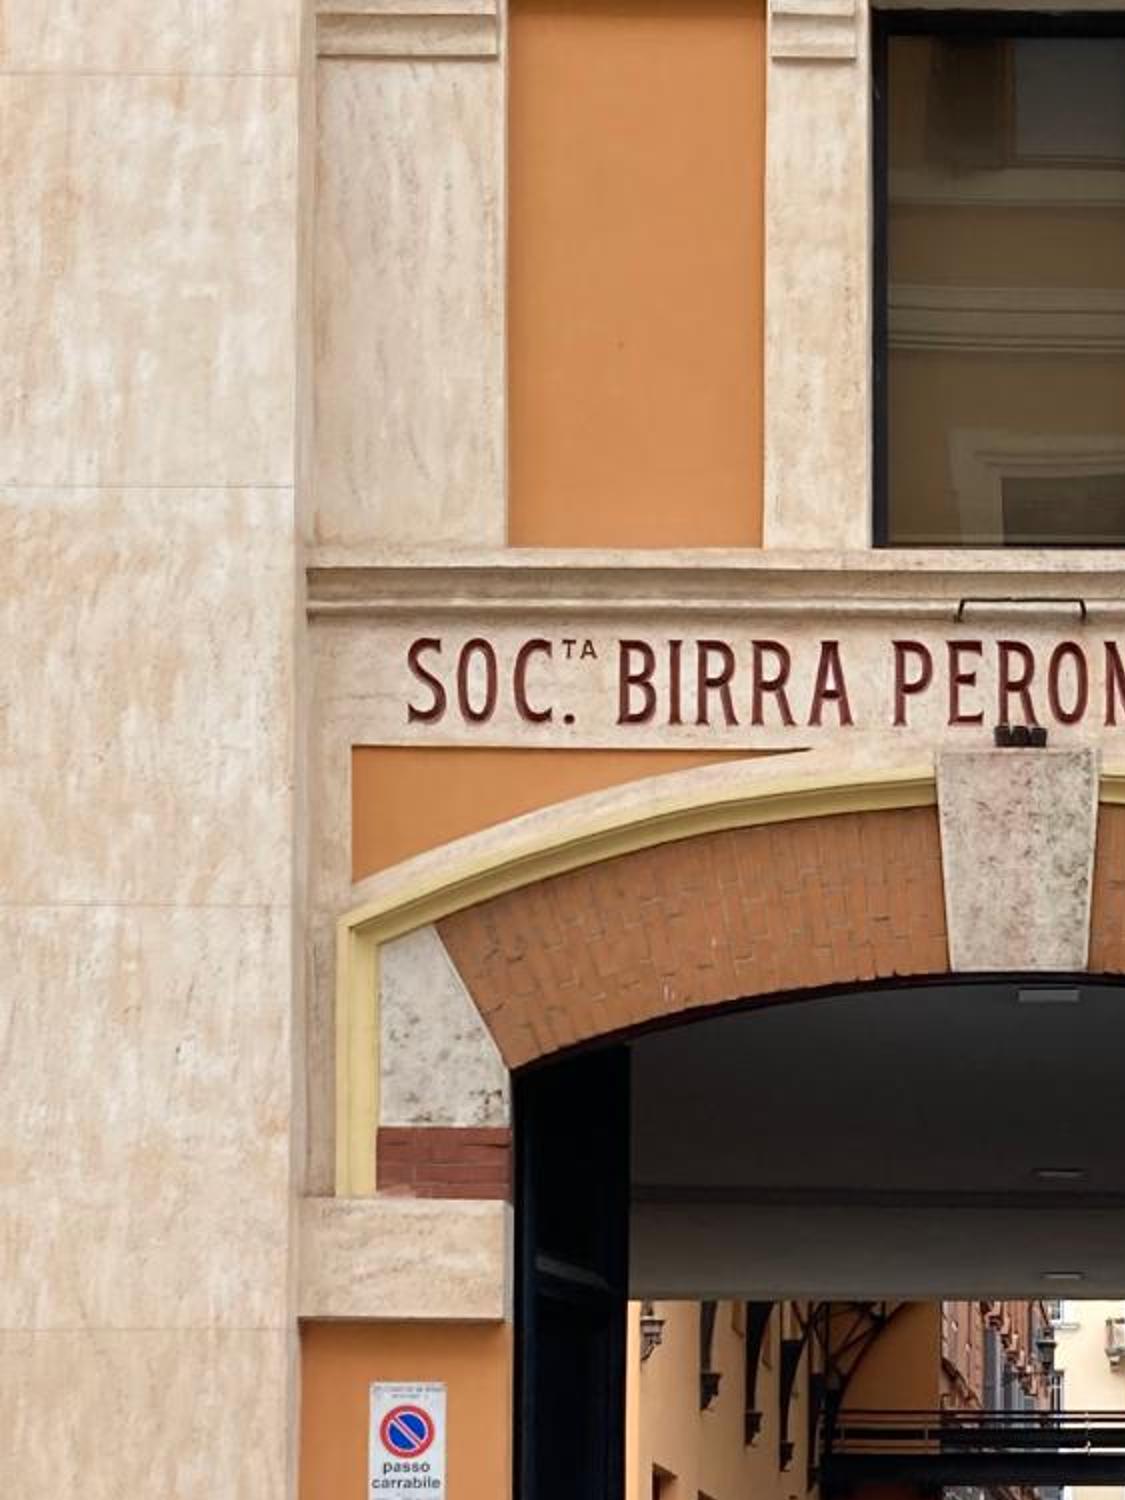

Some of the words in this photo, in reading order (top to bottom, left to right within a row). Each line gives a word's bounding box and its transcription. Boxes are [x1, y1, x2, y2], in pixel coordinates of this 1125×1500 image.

[616, 639, 854, 727] BIRRA
[383, 1462, 431, 1475] passo
[371, 1477, 441, 1489] carrabile
